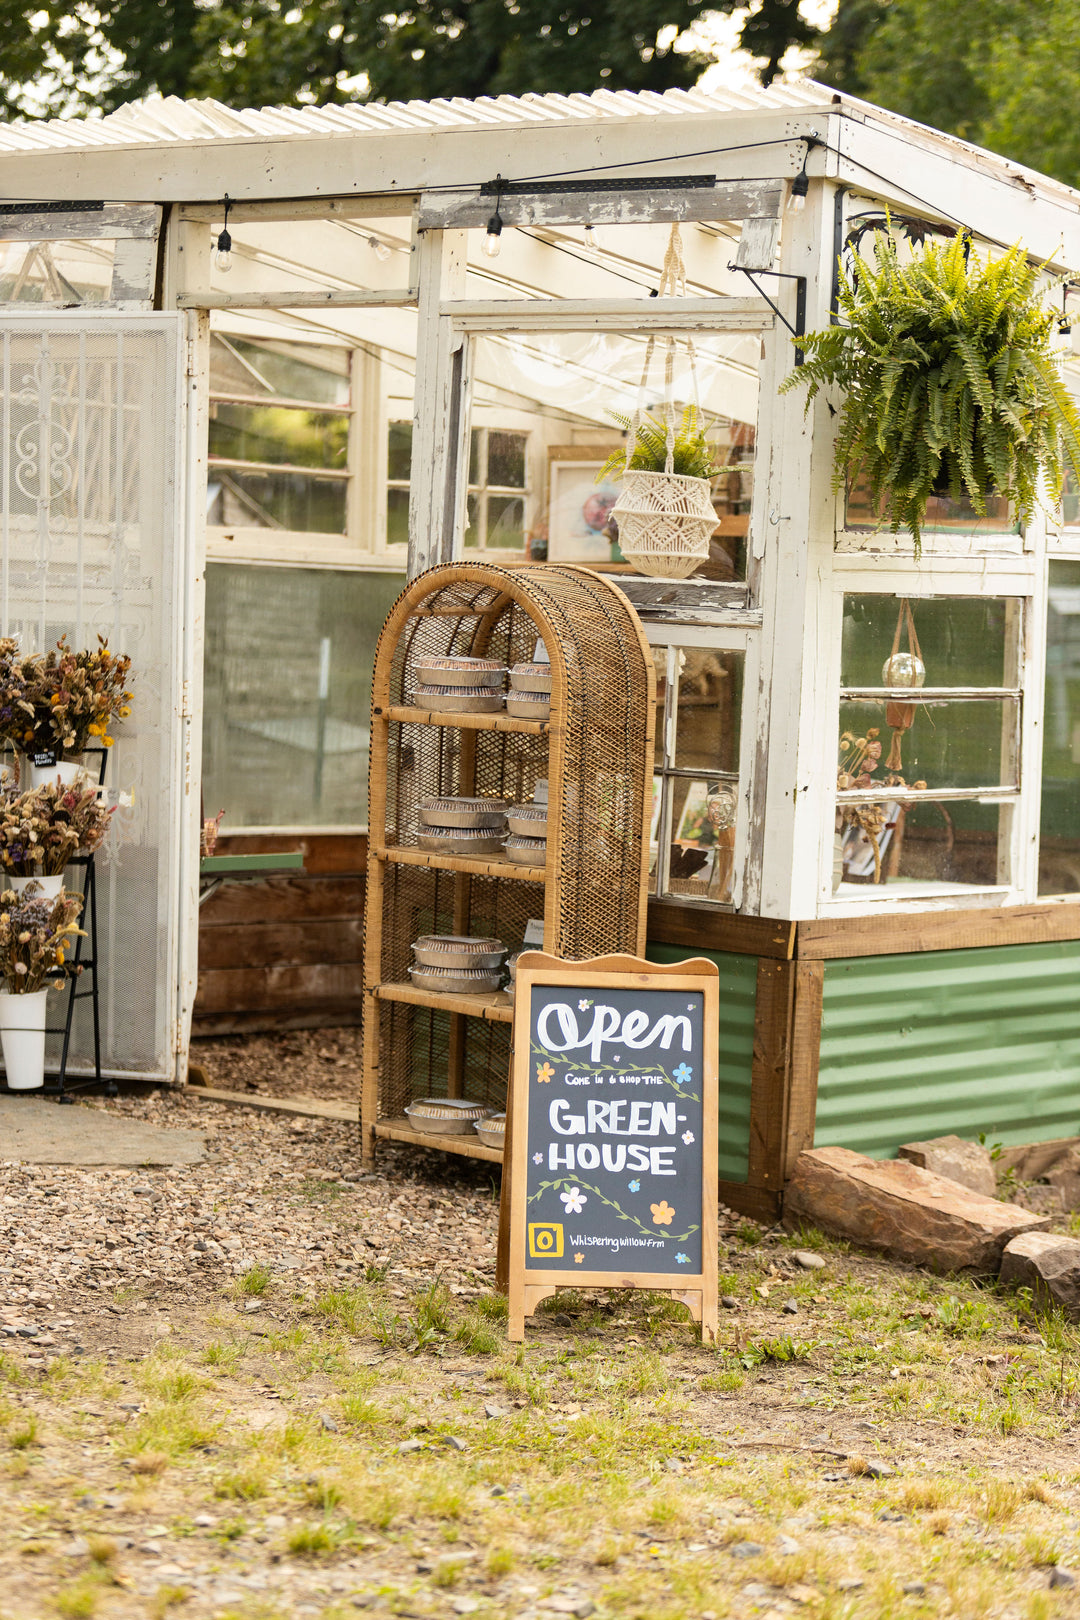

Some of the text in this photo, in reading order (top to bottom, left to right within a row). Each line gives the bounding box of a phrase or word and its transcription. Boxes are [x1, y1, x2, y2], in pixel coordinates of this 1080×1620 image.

[536, 1002, 693, 1063] Open
[609, 1074, 617, 1085] &
[619, 1076, 641, 1086] SHOP
[641, 1075, 664, 1085] THE
[549, 1098, 688, 1137] GREEN-
[548, 1142, 677, 1176] HOUSE
